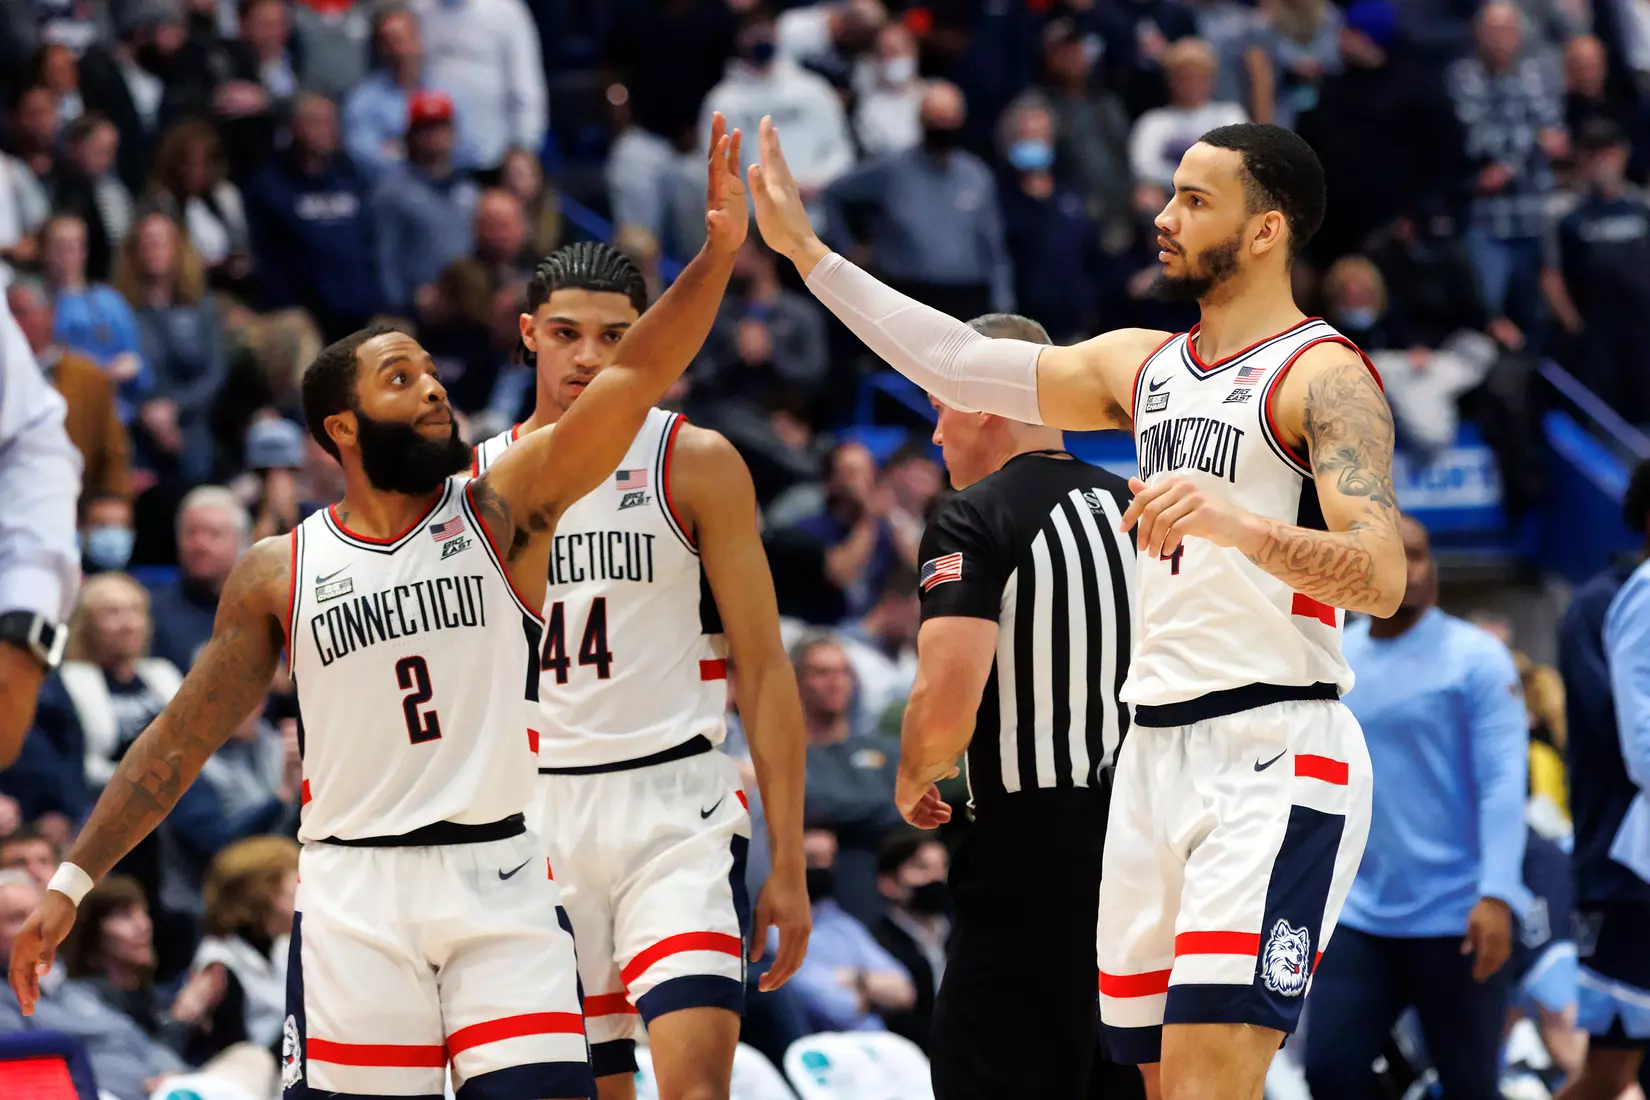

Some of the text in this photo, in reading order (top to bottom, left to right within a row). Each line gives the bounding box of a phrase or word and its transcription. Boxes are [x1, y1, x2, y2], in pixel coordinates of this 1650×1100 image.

[1139, 417, 1245, 483] CONNECTICUT
[311, 575, 486, 667] CONNECTICUT
[541, 597, 613, 684] 44
[395, 656, 442, 745] 2
